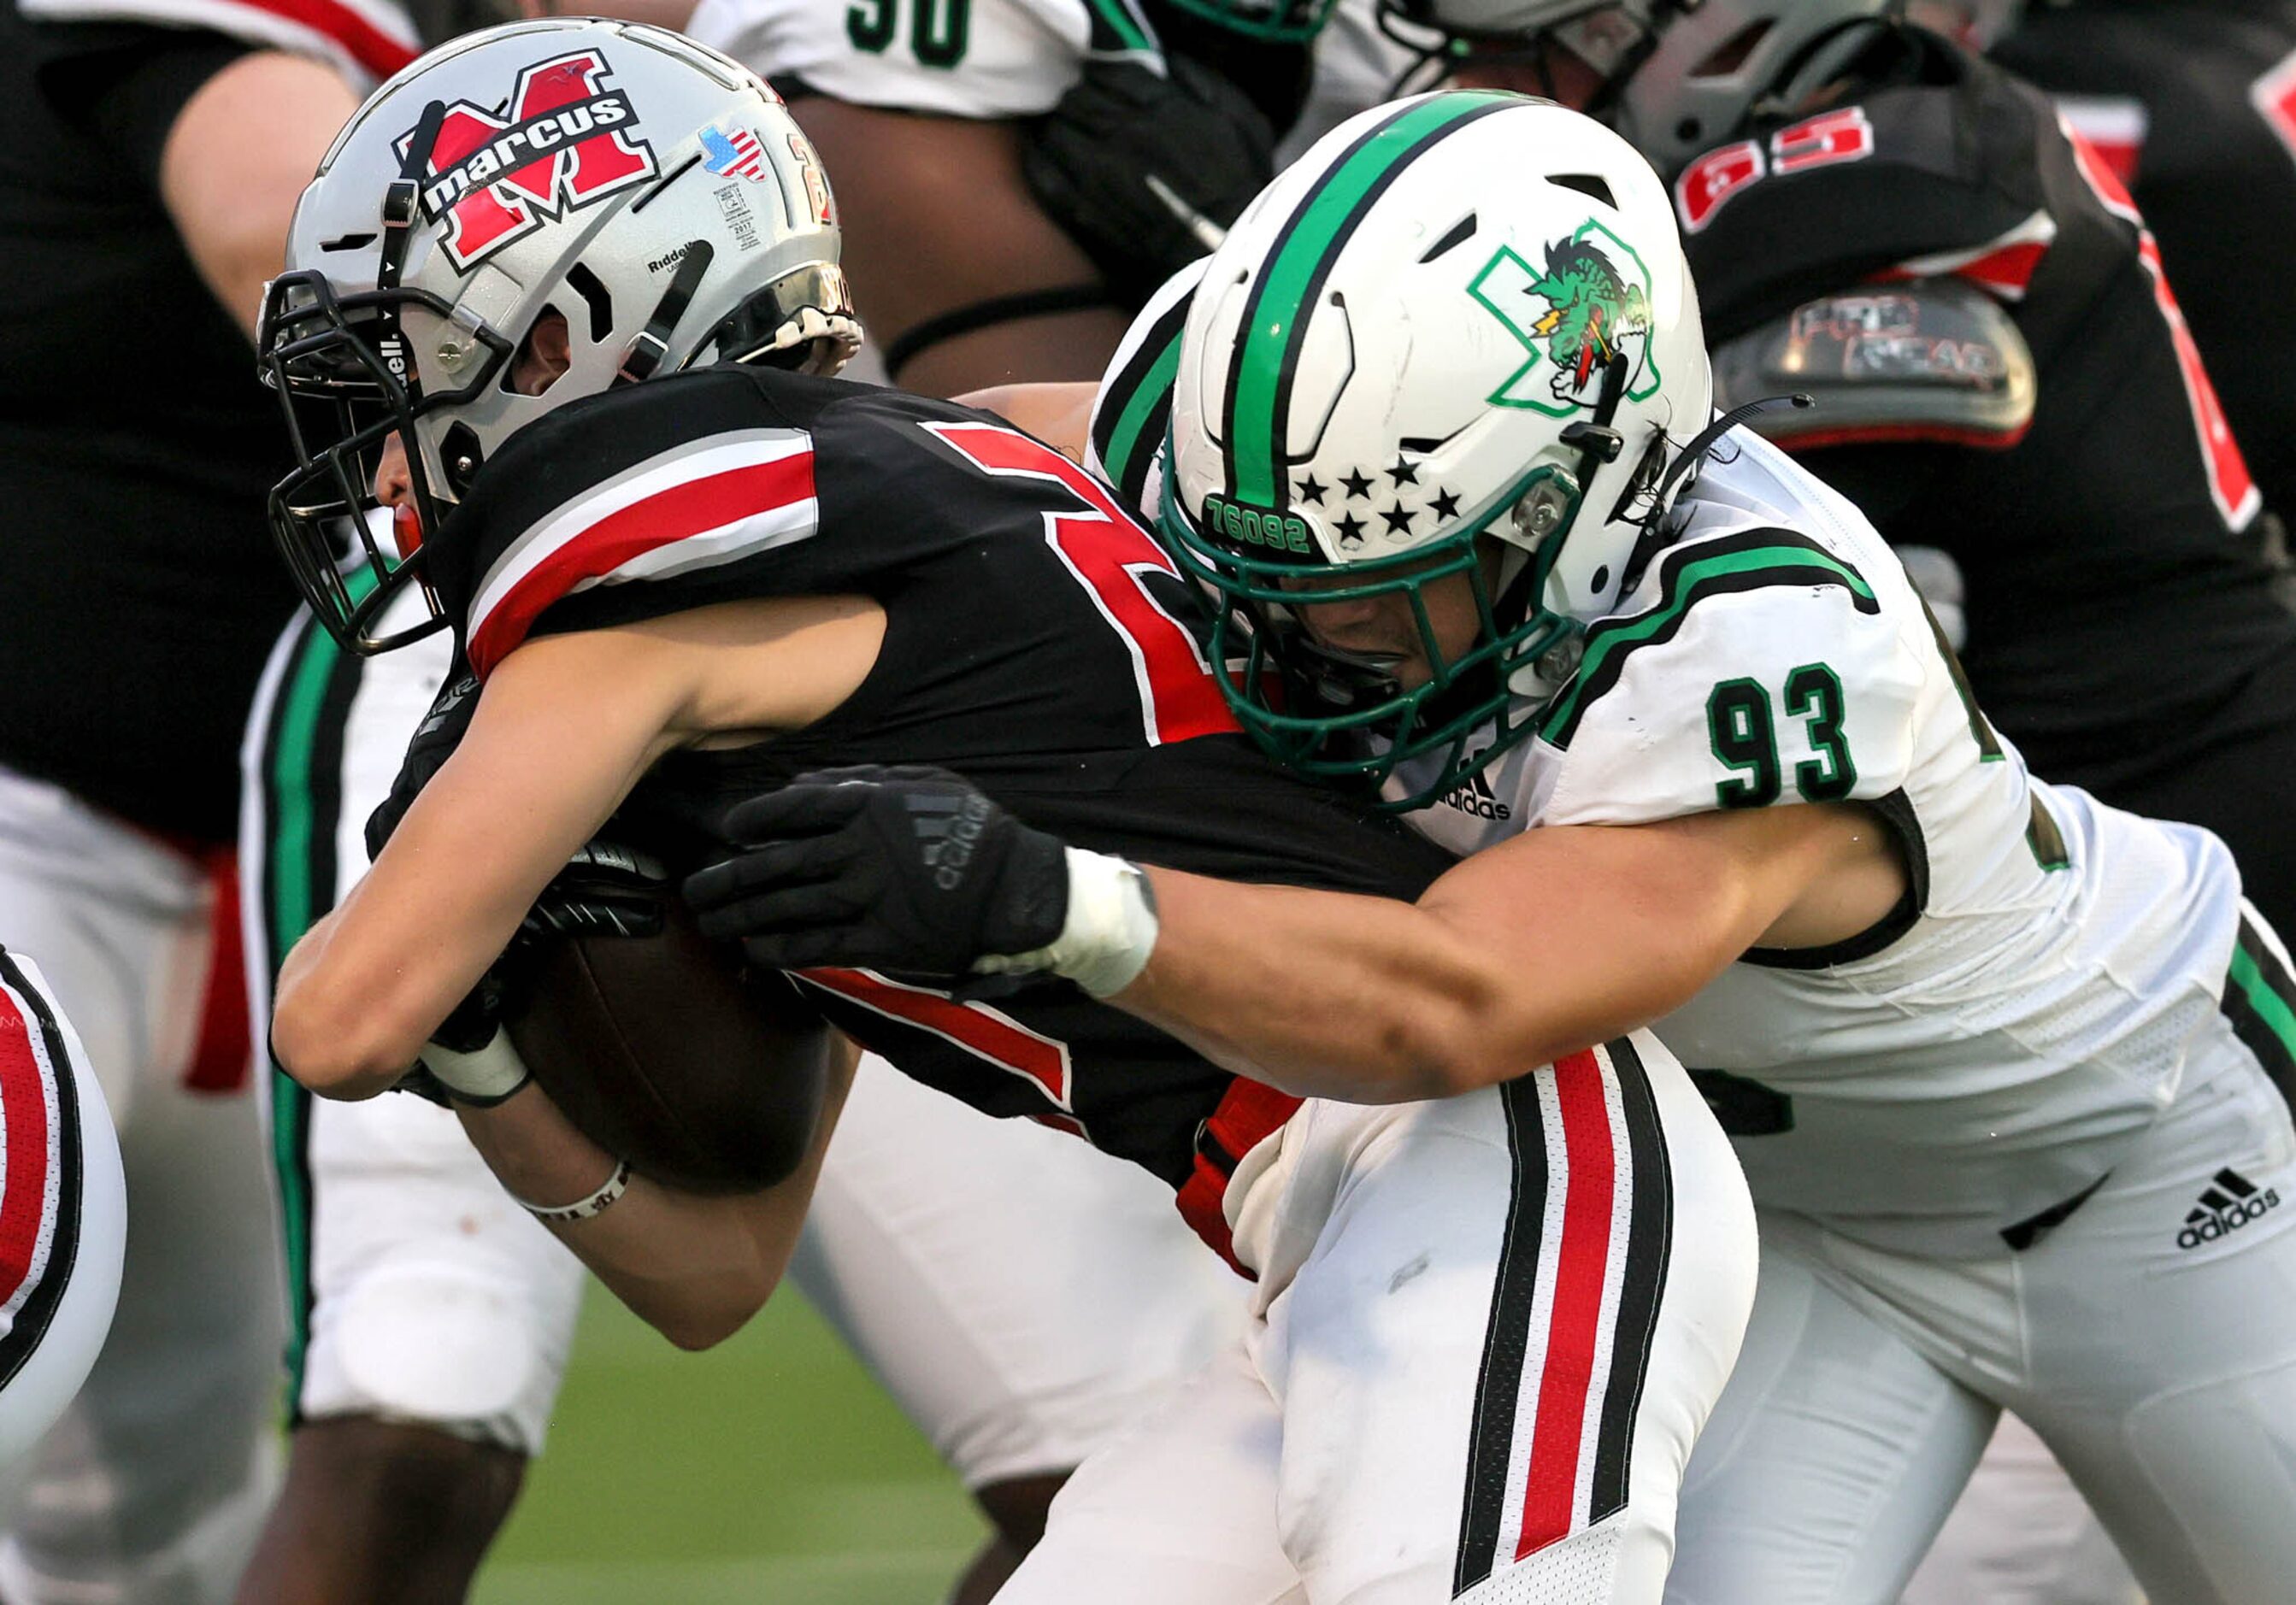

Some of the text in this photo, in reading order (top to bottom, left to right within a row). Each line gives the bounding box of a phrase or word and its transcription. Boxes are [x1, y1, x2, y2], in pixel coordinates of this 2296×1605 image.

[424, 98, 627, 214] marcus
[1205, 497, 1310, 554] 76092
[1705, 661, 1857, 809] 93
[2176, 1188, 2281, 1249] adidas
